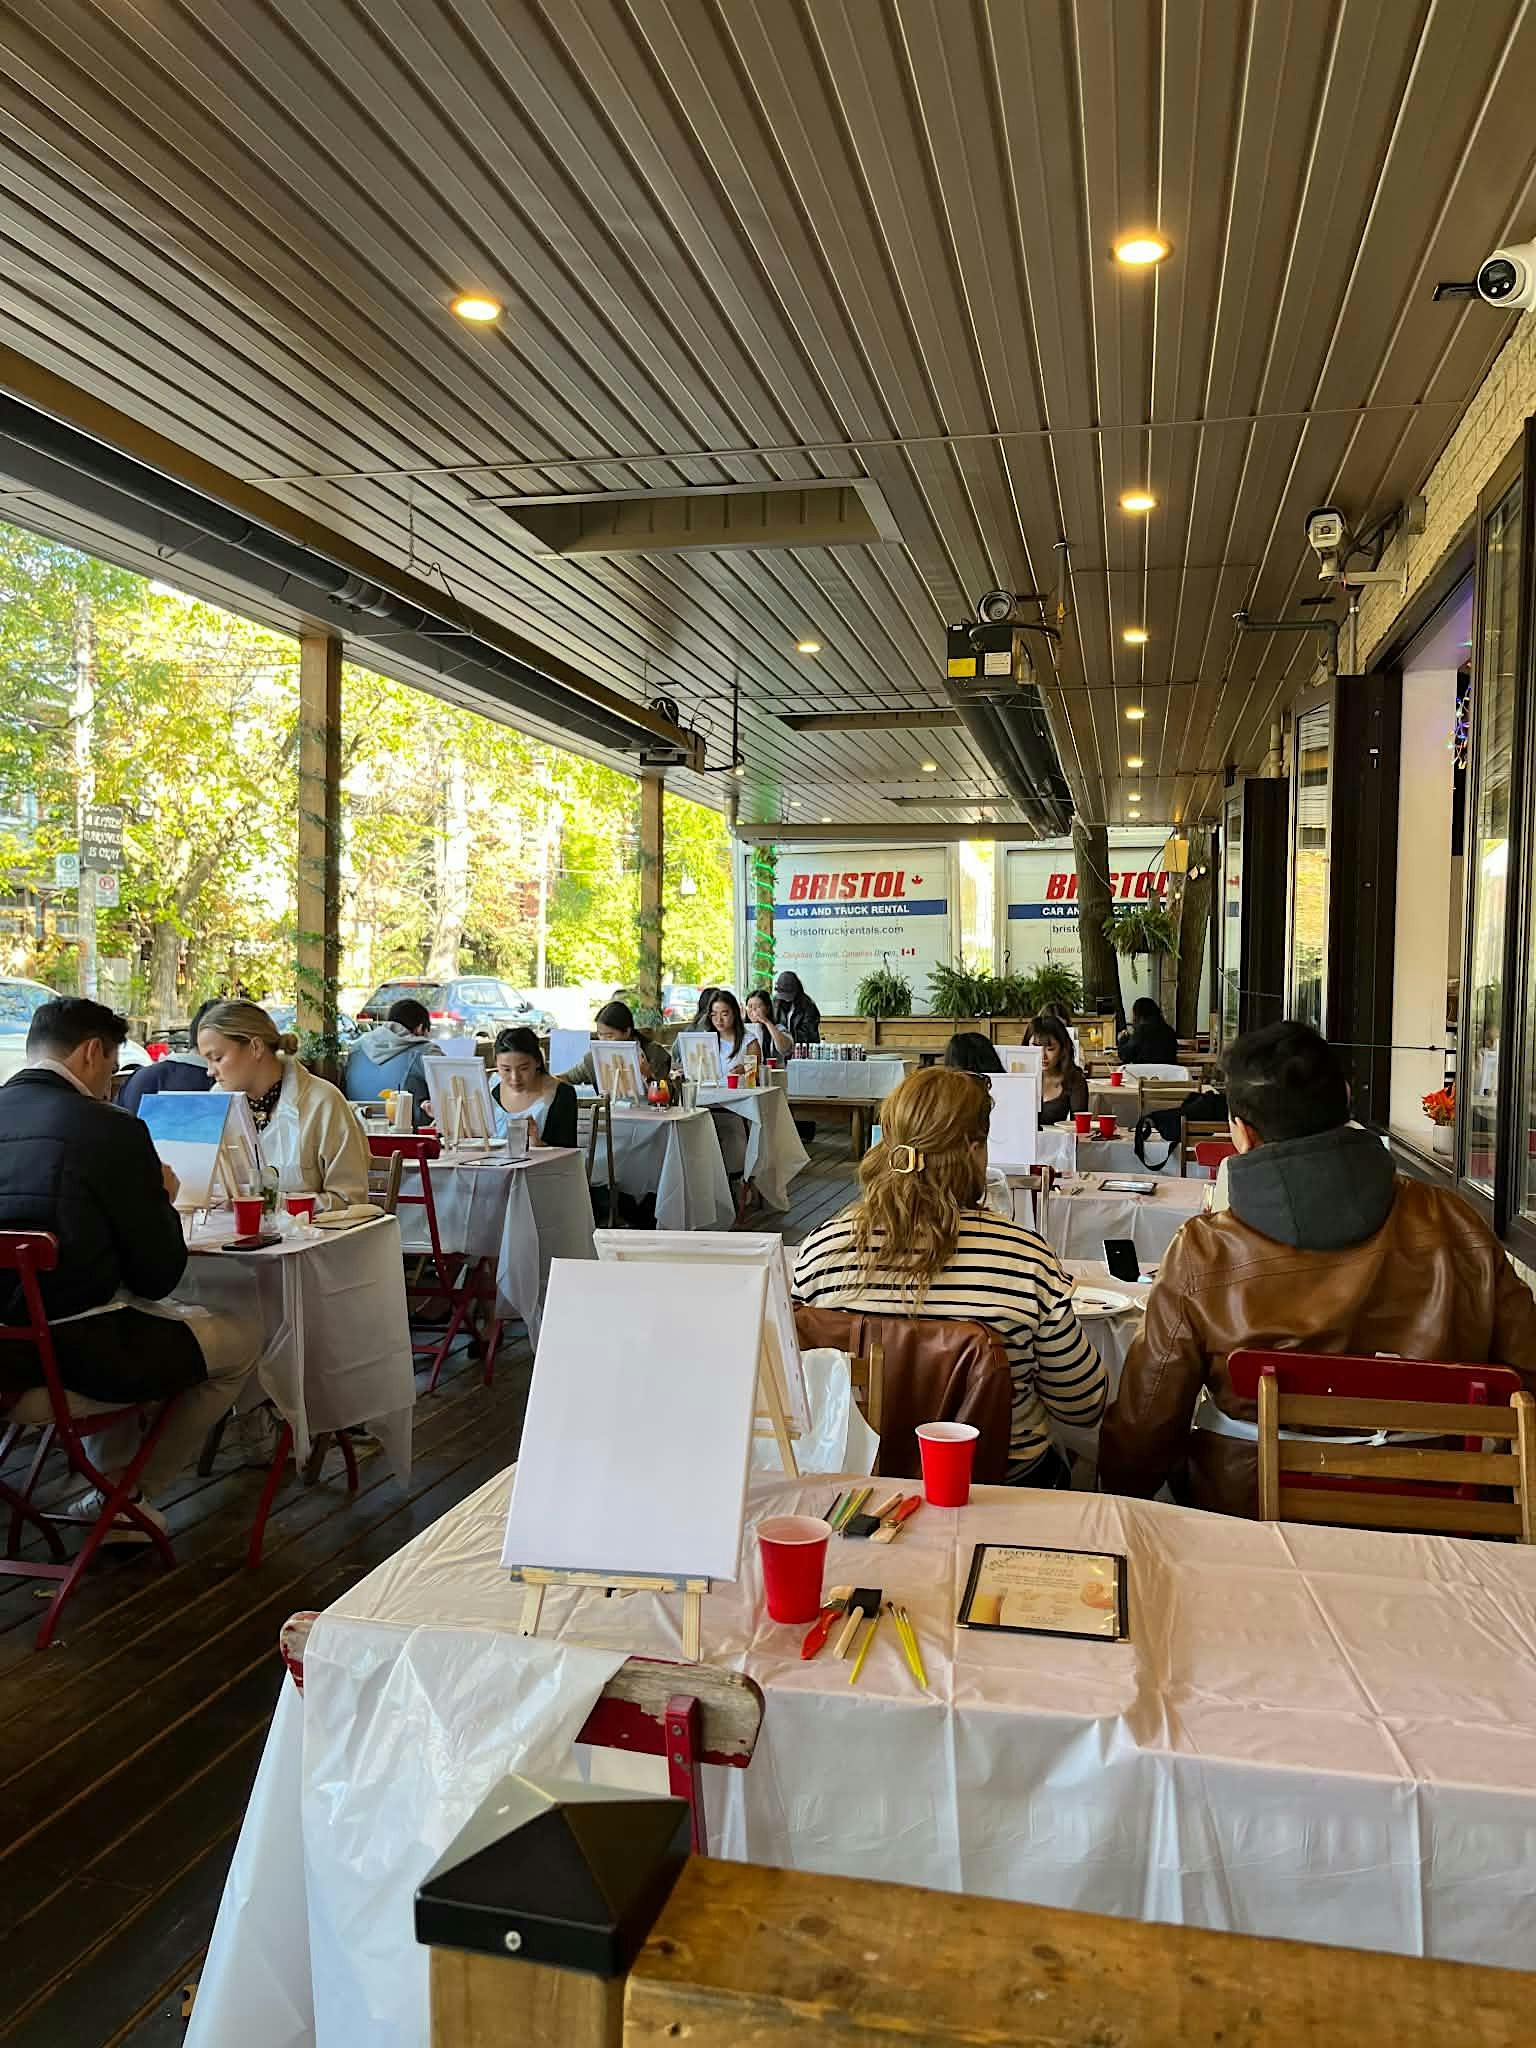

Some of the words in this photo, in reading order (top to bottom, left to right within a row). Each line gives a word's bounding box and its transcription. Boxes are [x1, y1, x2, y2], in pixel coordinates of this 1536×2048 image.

[789, 872, 906, 900] BRISTOL
[787, 908, 809, 917] CAR
[810, 907, 832, 916] AND
[833, 906, 869, 915] TRUCK
[871, 904, 910, 914] RENTAL
[1042, 907, 1065, 916] CAR
[790, 925, 904, 937] bristoltruckrentals.com
